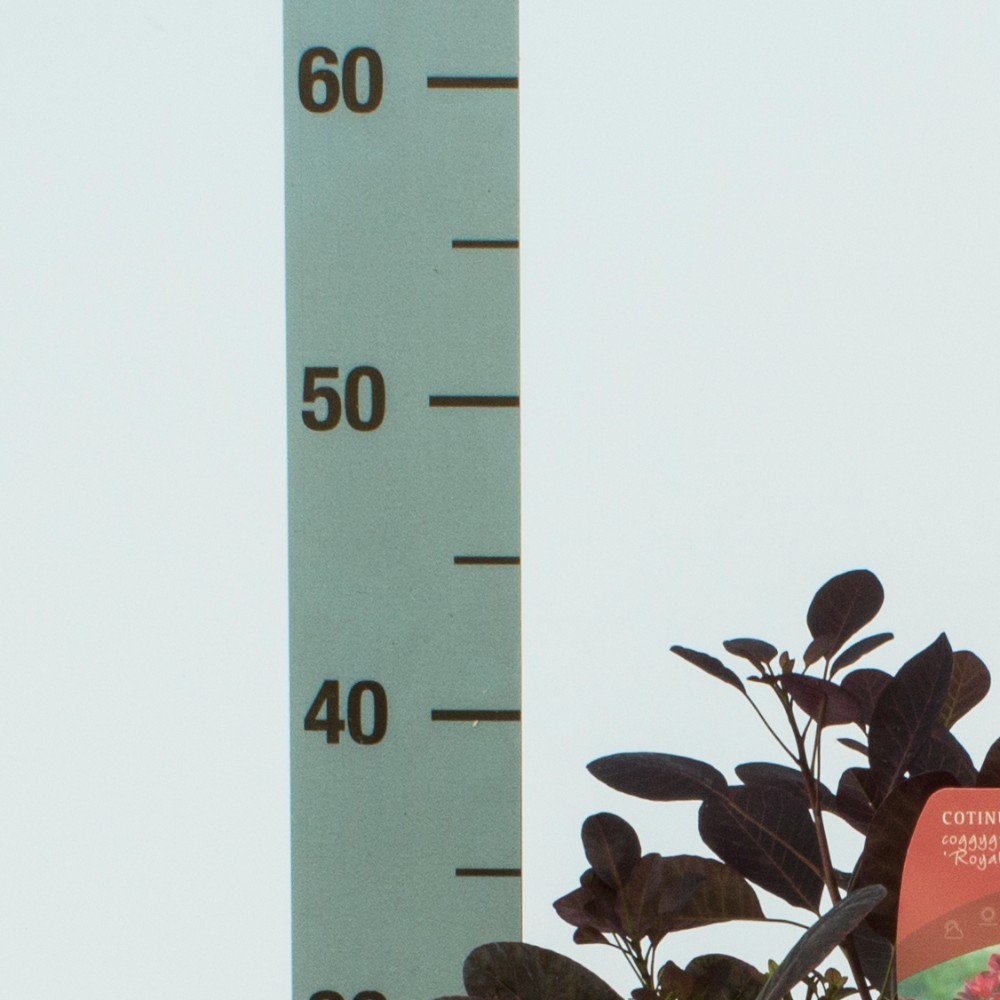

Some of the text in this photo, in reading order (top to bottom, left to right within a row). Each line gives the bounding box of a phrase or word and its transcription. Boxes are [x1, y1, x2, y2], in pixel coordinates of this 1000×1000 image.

[298, 46, 383, 113] 60
[301, 365, 386, 432] 50
[303, 679, 388, 746] 40
